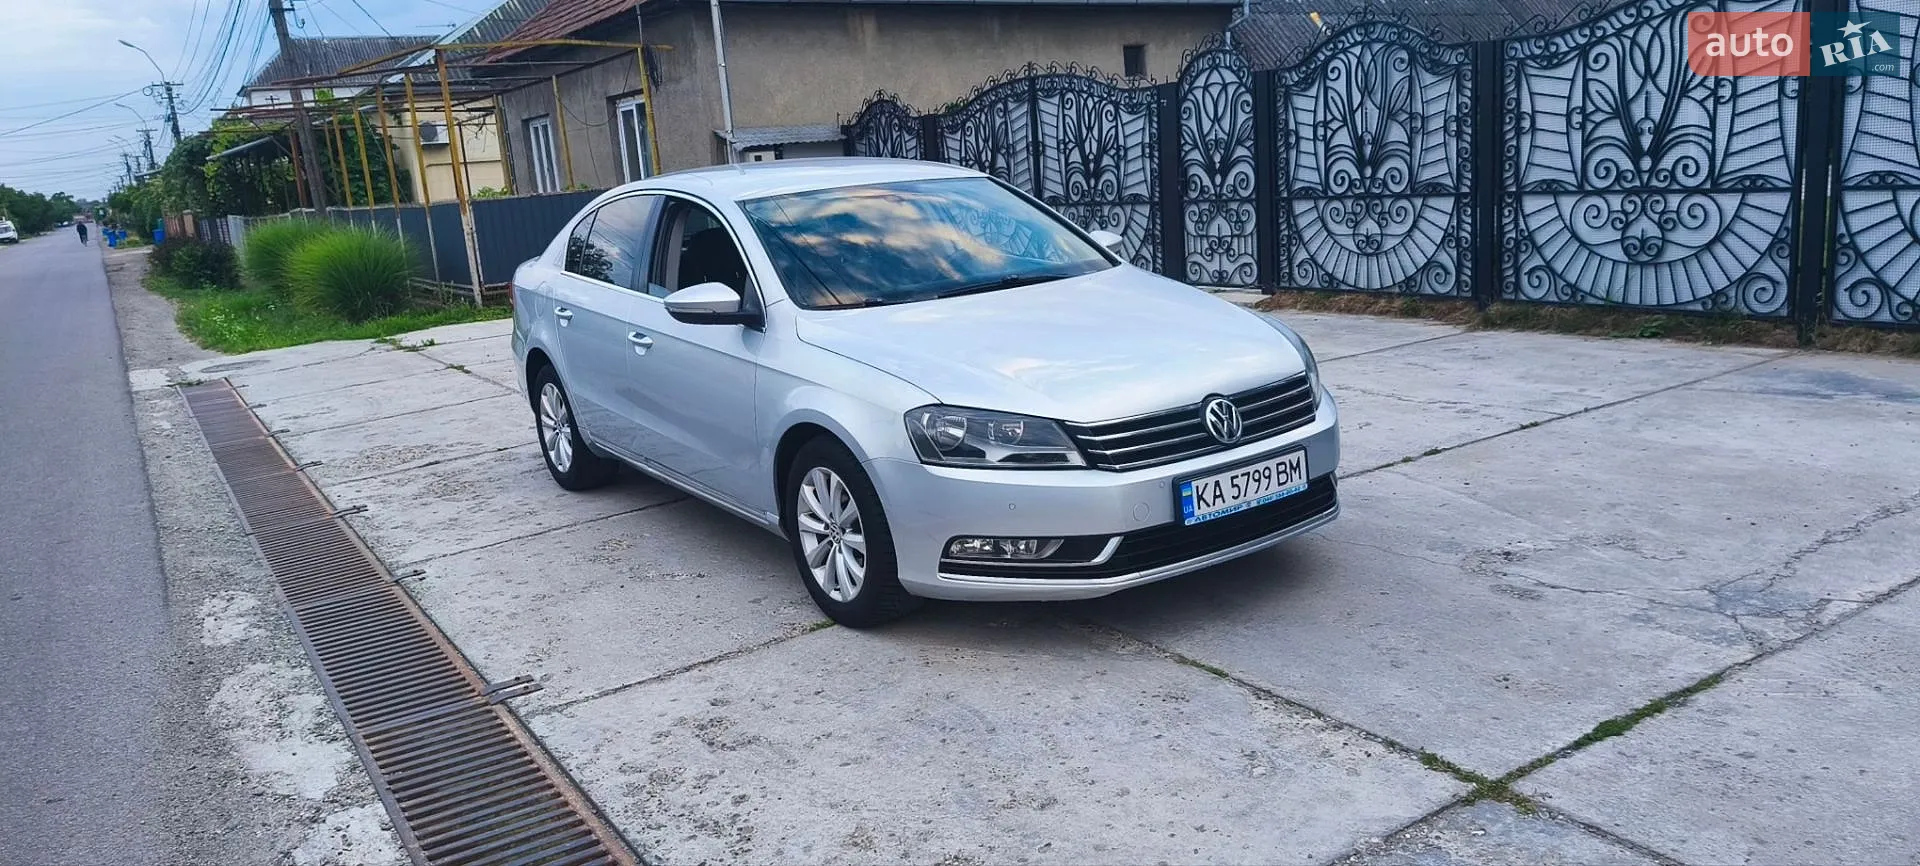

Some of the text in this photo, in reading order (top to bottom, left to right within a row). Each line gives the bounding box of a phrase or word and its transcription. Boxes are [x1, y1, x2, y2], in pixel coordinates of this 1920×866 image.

[1196, 479, 1226, 510] KA
[1230, 466, 1272, 500] 5799
[1276, 455, 1302, 487] BM
[1183, 504, 1193, 514] UA
